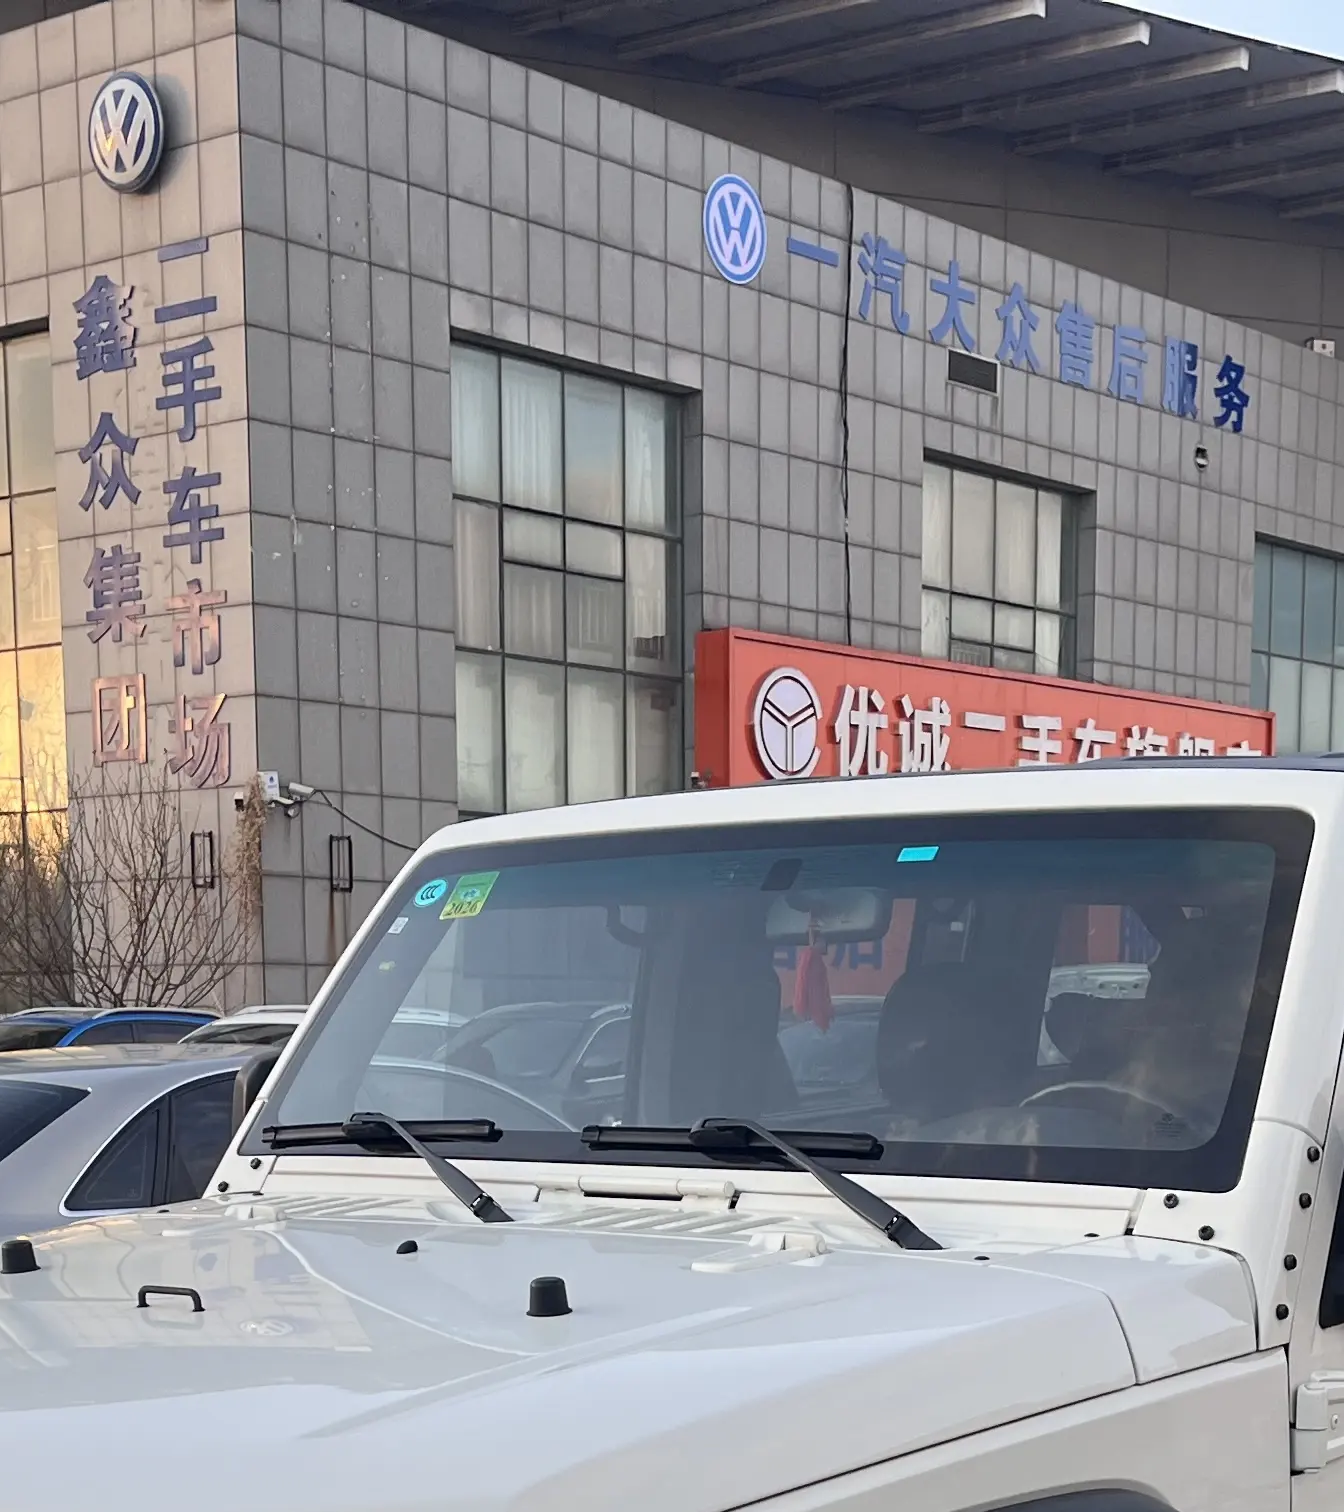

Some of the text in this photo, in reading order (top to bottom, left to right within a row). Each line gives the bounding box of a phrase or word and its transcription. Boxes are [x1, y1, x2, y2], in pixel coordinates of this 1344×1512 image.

[73, 274, 147, 769] 鑫众集团
[155, 237, 232, 789] 二手车市场
[787, 232, 1250, 433] 一汽大众售后服务
